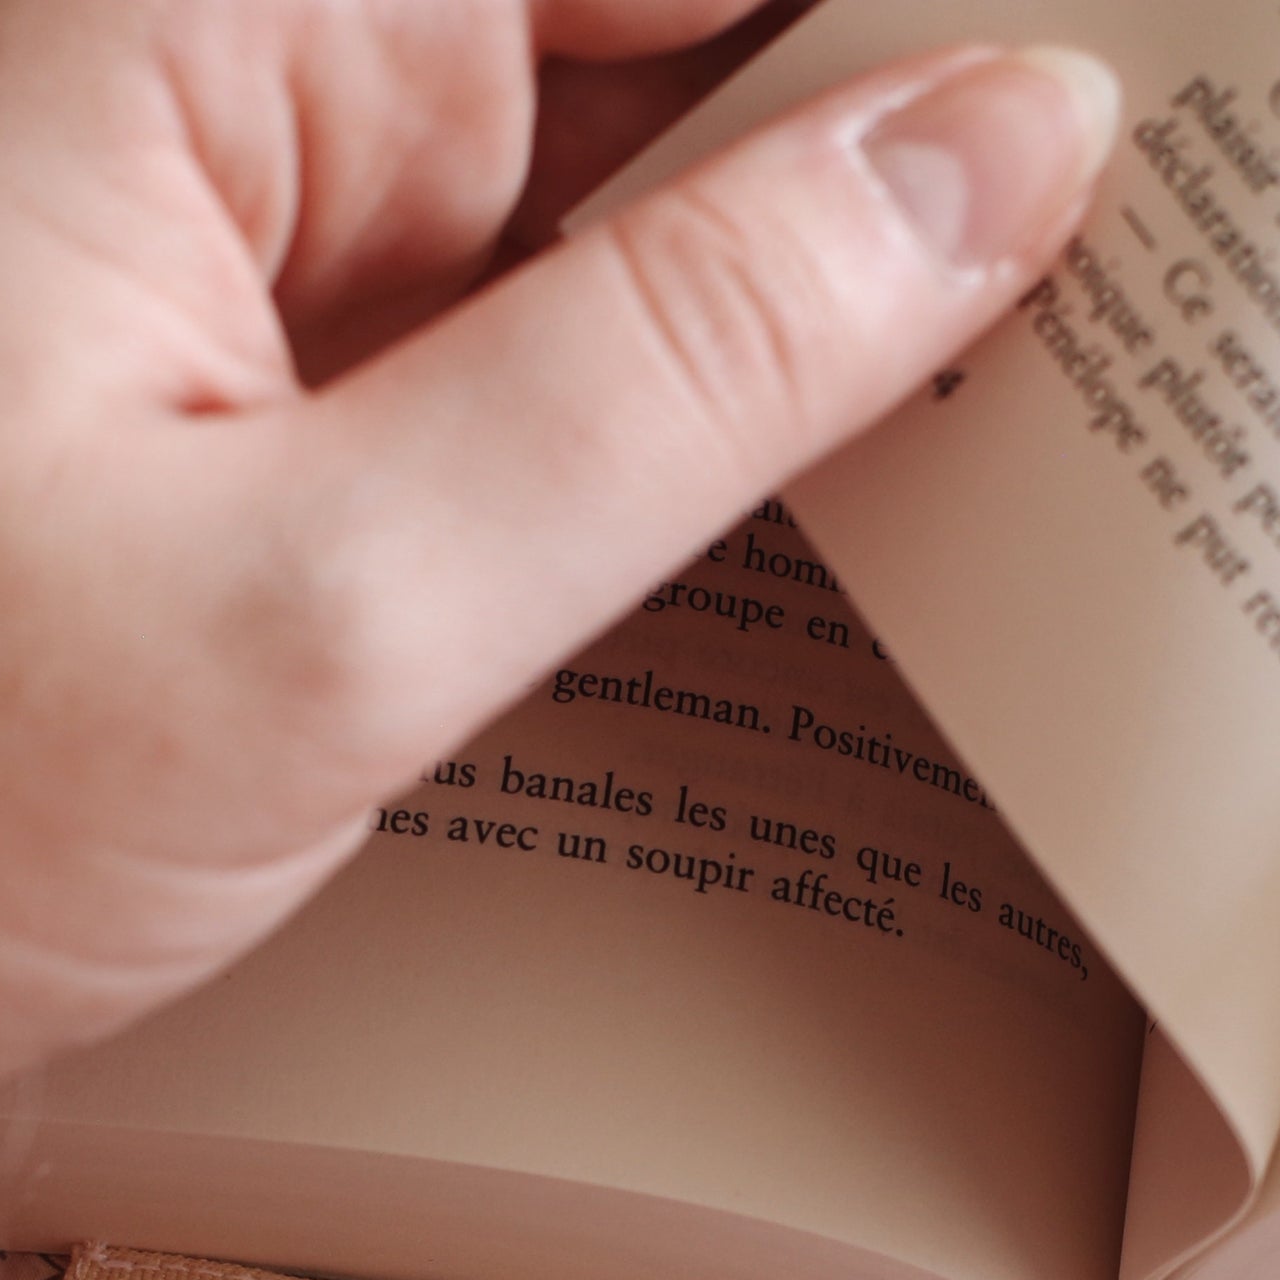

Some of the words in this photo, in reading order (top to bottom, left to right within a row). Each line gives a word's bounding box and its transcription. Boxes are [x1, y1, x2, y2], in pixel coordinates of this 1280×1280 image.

[1162, 256, 1215, 325] Ce
[1015, 272, 1148, 454] Pénélope
[1139, 454, 1190, 513] ne
[1173, 511, 1251, 588] put
[1137, 356, 1249, 481] plutôt
[642, 582, 785, 632] groupe
[807, 614, 850, 648] en
[552, 665, 772, 735] gentleman.
[423, 759, 477, 788] us
[500, 755, 654, 817] banales
[674, 785, 727, 832] les
[750, 814, 836, 860] unes
[856, 844, 922, 886] que
[939, 862, 982, 912] les
[998, 902, 1089, 981] autres,
[447, 815, 539, 851] avec
[557, 832, 608, 863] un
[626, 843, 755, 894] soupir
[771, 869, 904, 937] affecté.
